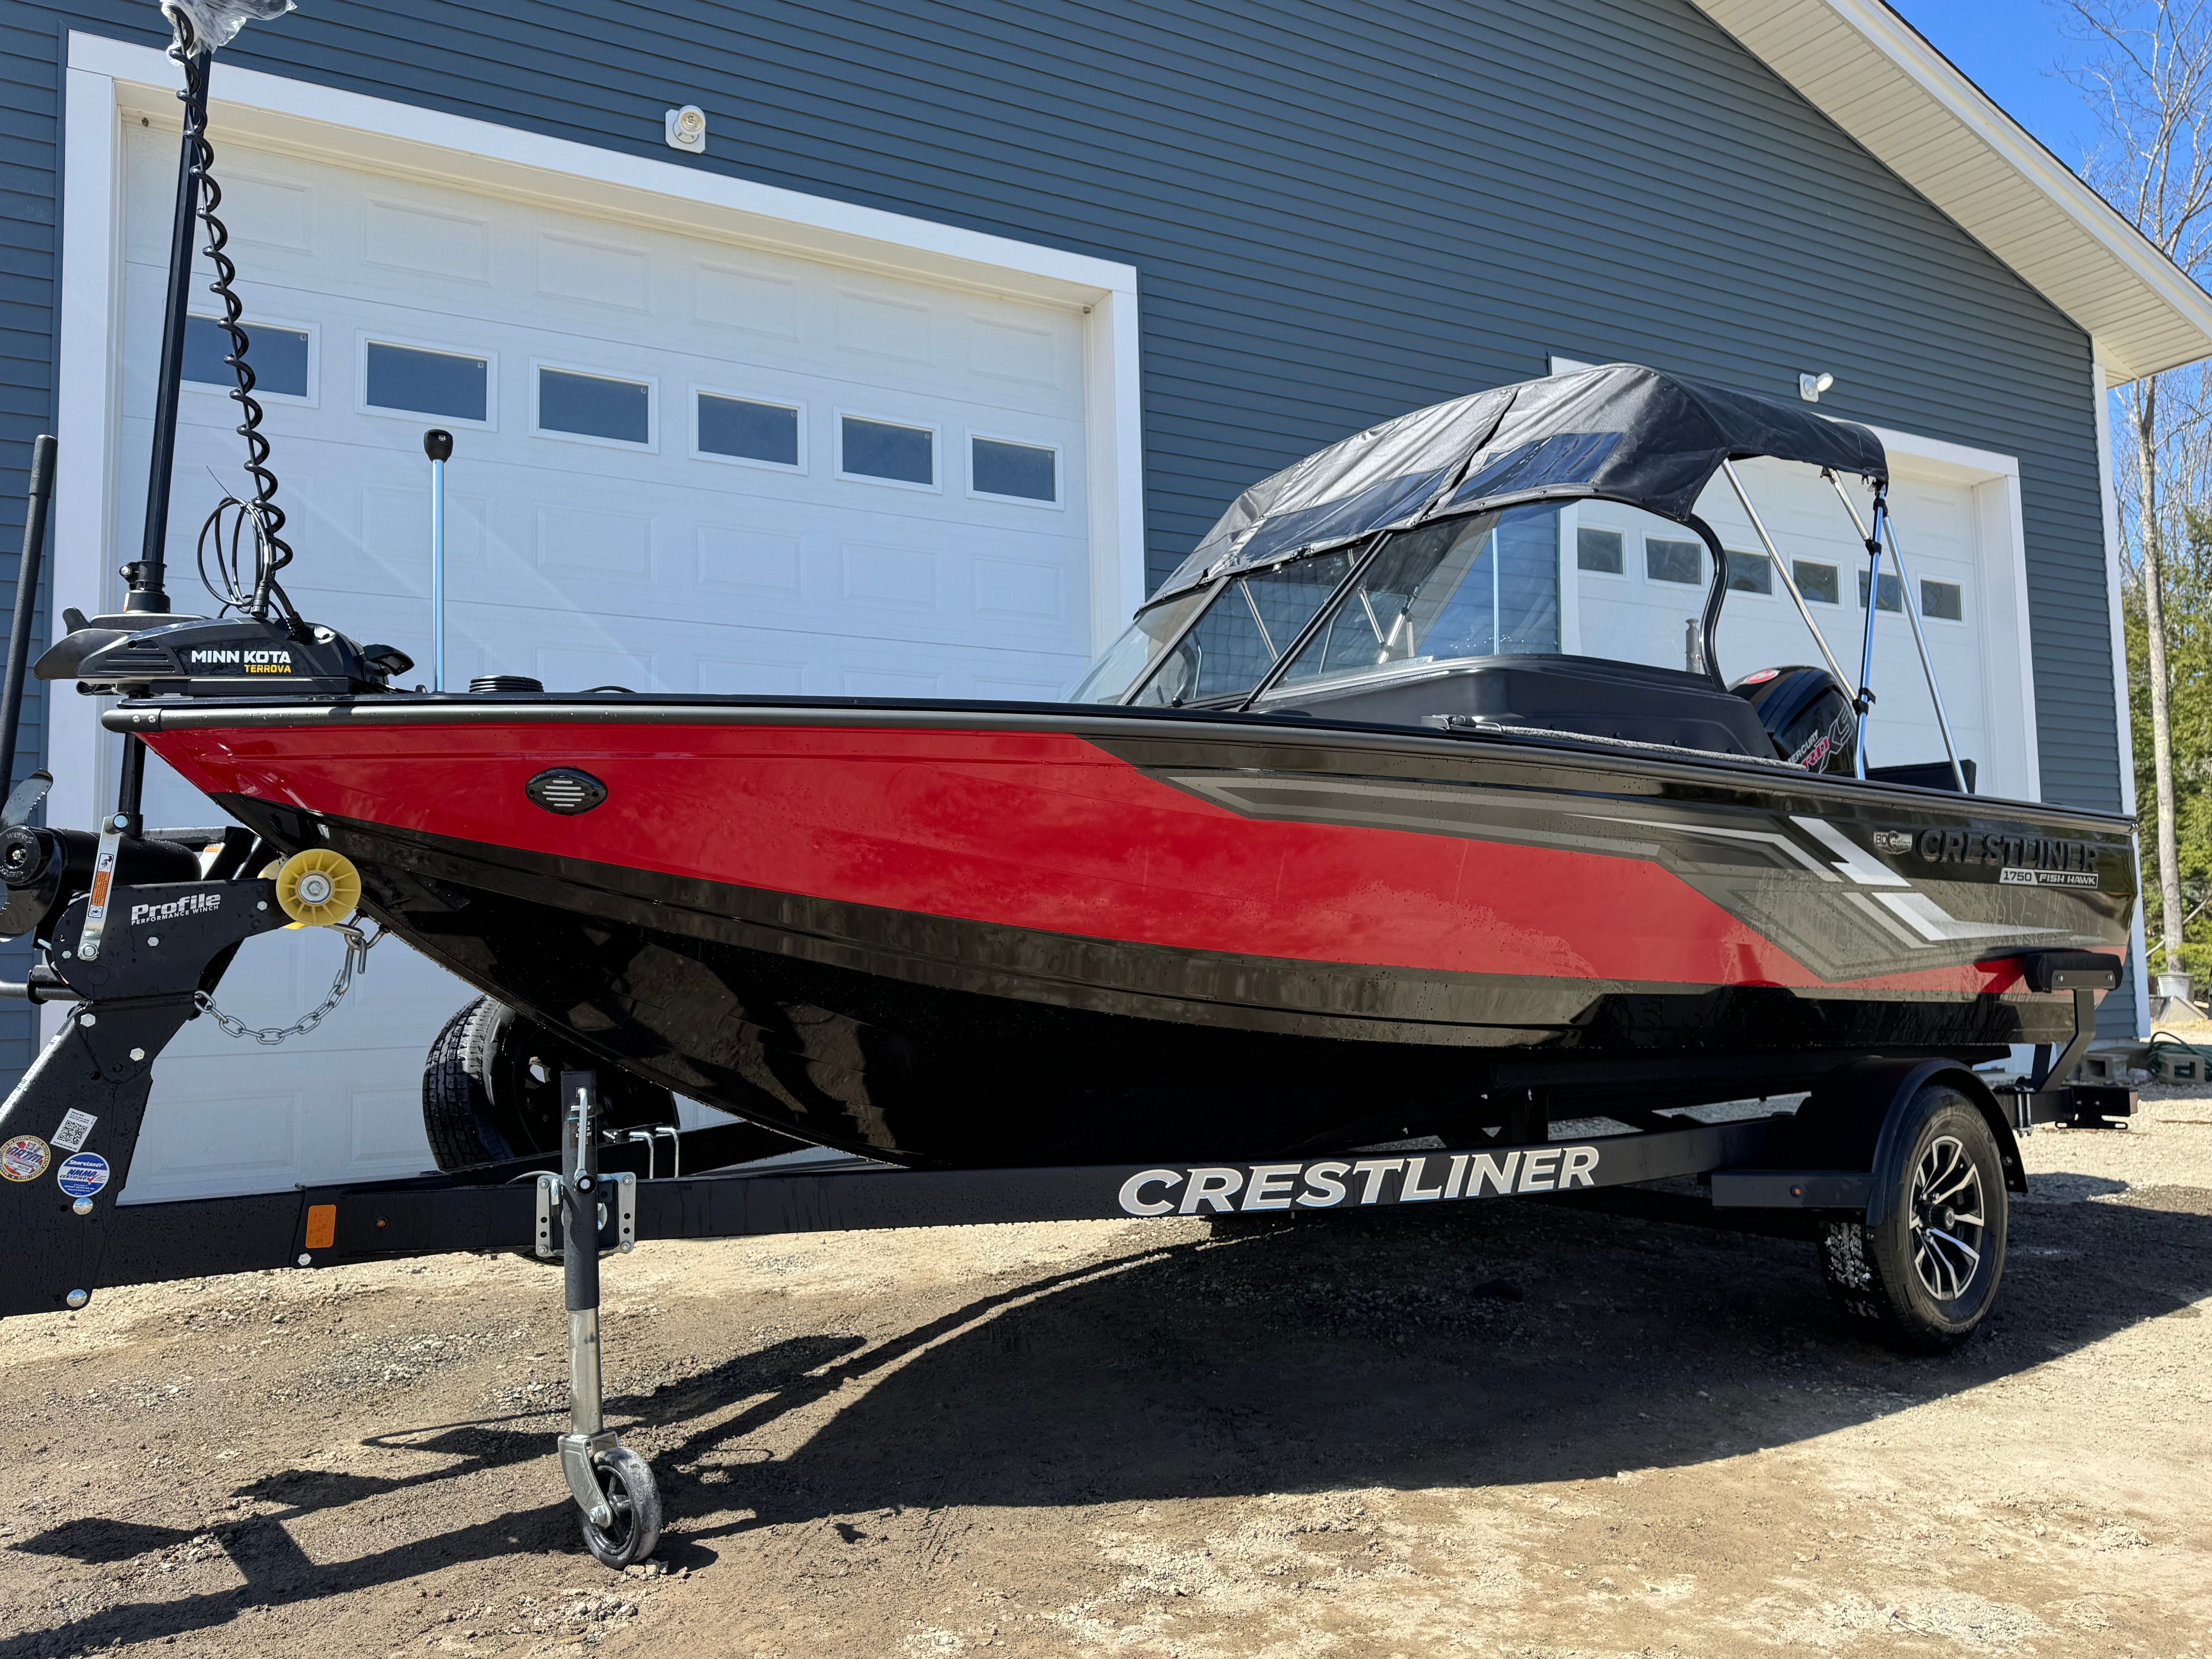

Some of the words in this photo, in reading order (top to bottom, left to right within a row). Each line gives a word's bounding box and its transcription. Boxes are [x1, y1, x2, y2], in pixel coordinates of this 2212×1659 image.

[191, 650, 240, 663] MINN
[244, 651, 292, 663] KOTA
[244, 664, 292, 673] TERROVA
[1800, 735, 1830, 772] RO
[1875, 834, 1887, 844] 80
[1917, 829, 2099, 872] CRESTLINER
[2003, 871, 2032, 882] 1750
[2039, 873, 2065, 883] FISH
[2067, 875, 2095, 885] HAWK
[131, 893, 221, 921] Profile
[131, 910, 190, 926] PERFORMANCE
[192, 904, 219, 914] WINCH
[5, 1146, 44, 1163] NATM
[67, 1169, 98, 1177] NMMA
[1118, 1146, 1600, 1216] CRESTLINER
